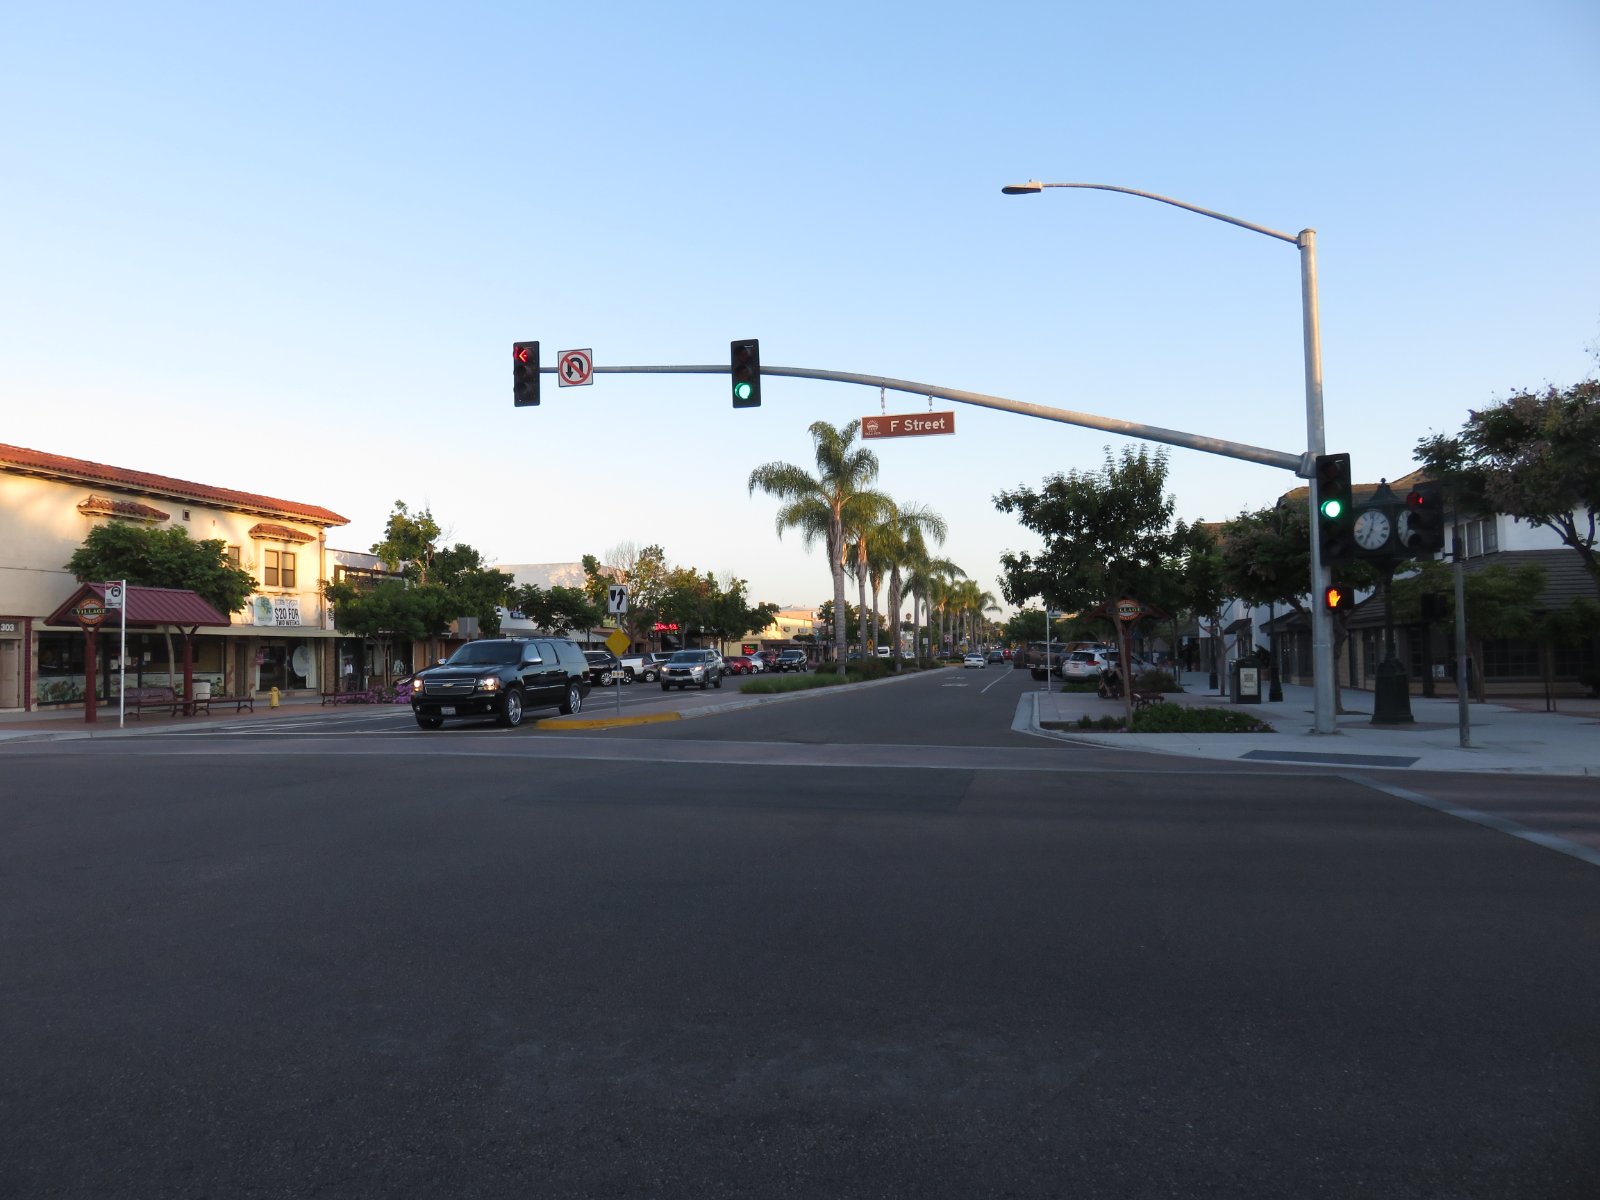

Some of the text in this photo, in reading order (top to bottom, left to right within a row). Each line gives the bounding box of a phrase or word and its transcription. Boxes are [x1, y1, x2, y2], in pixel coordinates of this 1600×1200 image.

[890, 418, 945, 432] F Street
[274, 608, 299, 619] $20 FOR
